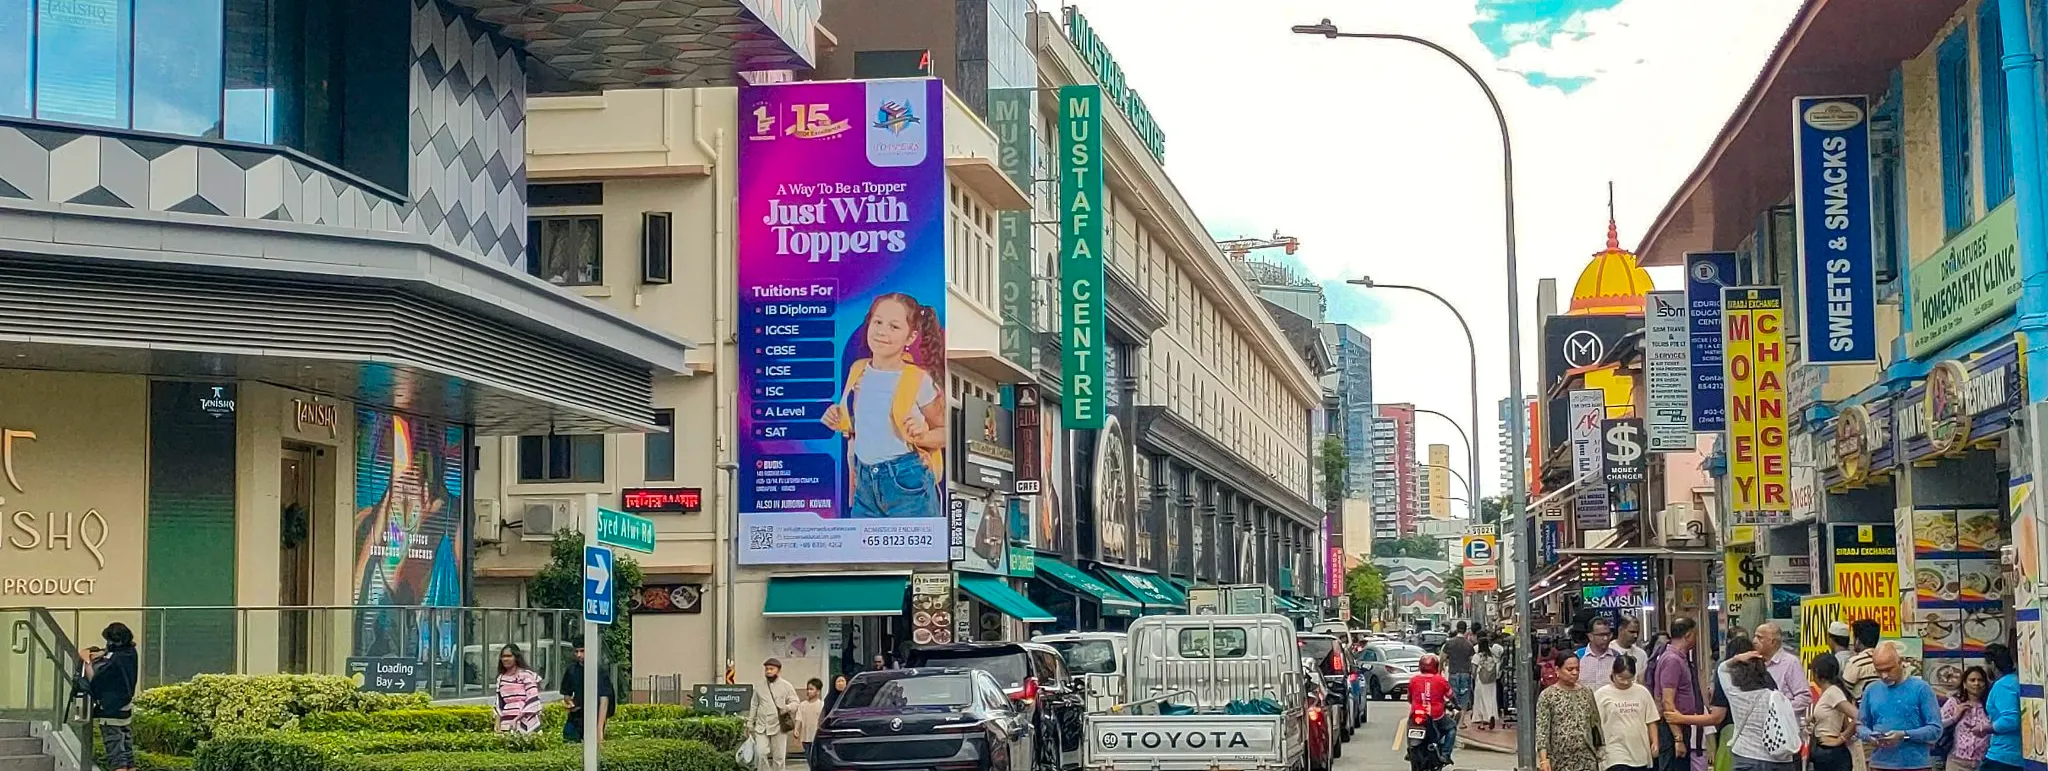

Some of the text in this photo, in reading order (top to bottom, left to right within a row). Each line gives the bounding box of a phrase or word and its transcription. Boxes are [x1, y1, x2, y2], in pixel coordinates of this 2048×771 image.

[1070, 5, 1165, 165] MUSTAFA CENTRE
[791, 103, 831, 132] 15
[776, 184, 787, 195] A
[788, 184, 815, 198] Way
[817, 183, 832, 194] To
[835, 182, 851, 193] Be
[862, 182, 906, 195] Topper
[1822, 135, 1850, 230] SNACKS
[763, 195, 910, 225] Just With
[771, 226, 906, 263] Toppers
[1829, 236, 1848, 251] &
[1070, 97, 1091, 419] MUSTAFA CENTRE
[752, 285, 833, 297] Tuitions For
[1921, 243, 2016, 330] HOMEOPATHY CLINIC
[765, 304, 827, 318] IB Diploma
[1826, 258, 1854, 353] SWEETS
[765, 325, 799, 336] IGCSE
[765, 345, 796, 355] CBSE
[765, 366, 791, 376] ICSE
[765, 386, 784, 396] ISC
[200, 398, 235, 411] TANISHQ
[765, 406, 805, 416] A Level
[1728, 314, 1754, 504] MONEY
[1757, 313, 1785, 504] CHANGER
[293, 395, 338, 437] TANISHQ
[765, 427, 787, 437] SAT
[1017, 482, 1038, 491] CAFE
[756, 498, 832, 509] ALSO IN JURONG KOVAN
[598, 512, 652, 544] Syed Alwi Rd
[862, 535, 932, 546] +65 8123 6342
[1861, 548, 1896, 556] EXCHANGE
[5, 578, 96, 595] PRODUCT
[1839, 572, 1896, 598] MONEY
[586, 598, 598, 615] ONE
[377, 662, 414, 676] Loading
[376, 676, 393, 689] Bay
[714, 695, 740, 703] Loading
[1105, 736, 1117, 745] 60
[1121, 731, 1249, 749] TOYOTA
